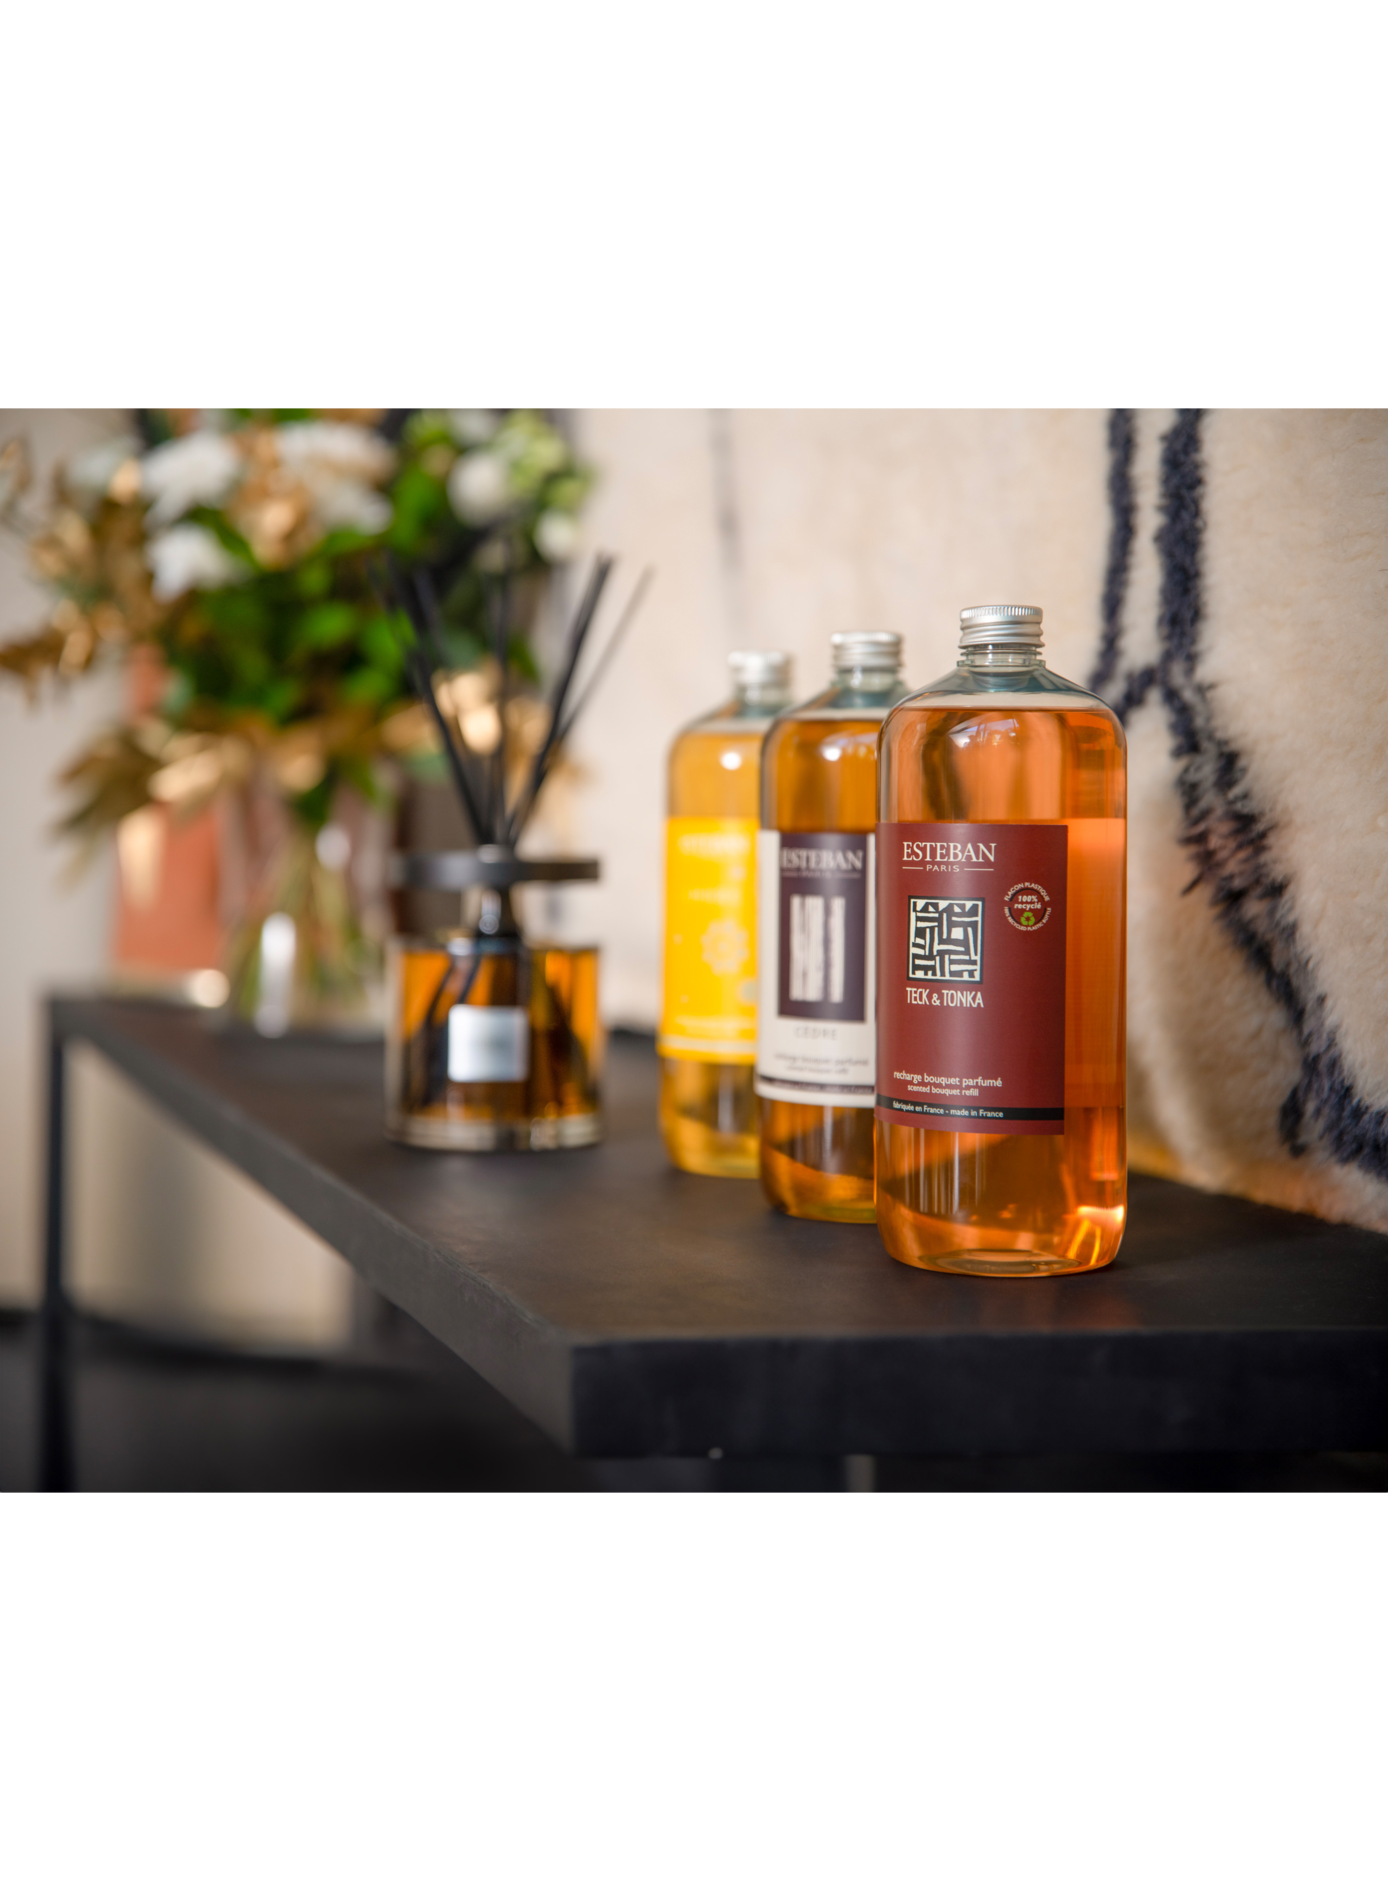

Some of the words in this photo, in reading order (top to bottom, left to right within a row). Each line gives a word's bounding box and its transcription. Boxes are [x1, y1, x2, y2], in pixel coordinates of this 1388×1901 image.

[780, 846, 864, 871] ESTEBAN
[902, 841, 997, 863] ESTEBAN
[926, 864, 960, 873] PARIS
[1004, 882, 1025, 902] FLACON
[1025, 881, 1051, 902] PLASTIQUE
[1018, 895, 1039, 903] 100%
[1014, 902, 1042, 911] recyclé
[906, 987, 930, 1005] TECK
[931, 993, 941, 1006] &
[942, 989, 984, 1008] TONKA
[893, 1070, 922, 1084] recharge
[924, 1073, 960, 1087] bouquet
[962, 1076, 1003, 1088] parfumé
[907, 1084, 931, 1093] scented
[931, 1086, 960, 1097] bouquet
[962, 1088, 979, 1097] refill
[893, 1100, 915, 1112] fabriquée
[923, 1105, 944, 1115] France
[950, 1108, 969, 1117] made
[971, 1109, 978, 1117] in
[979, 1109, 1004, 1118] France
